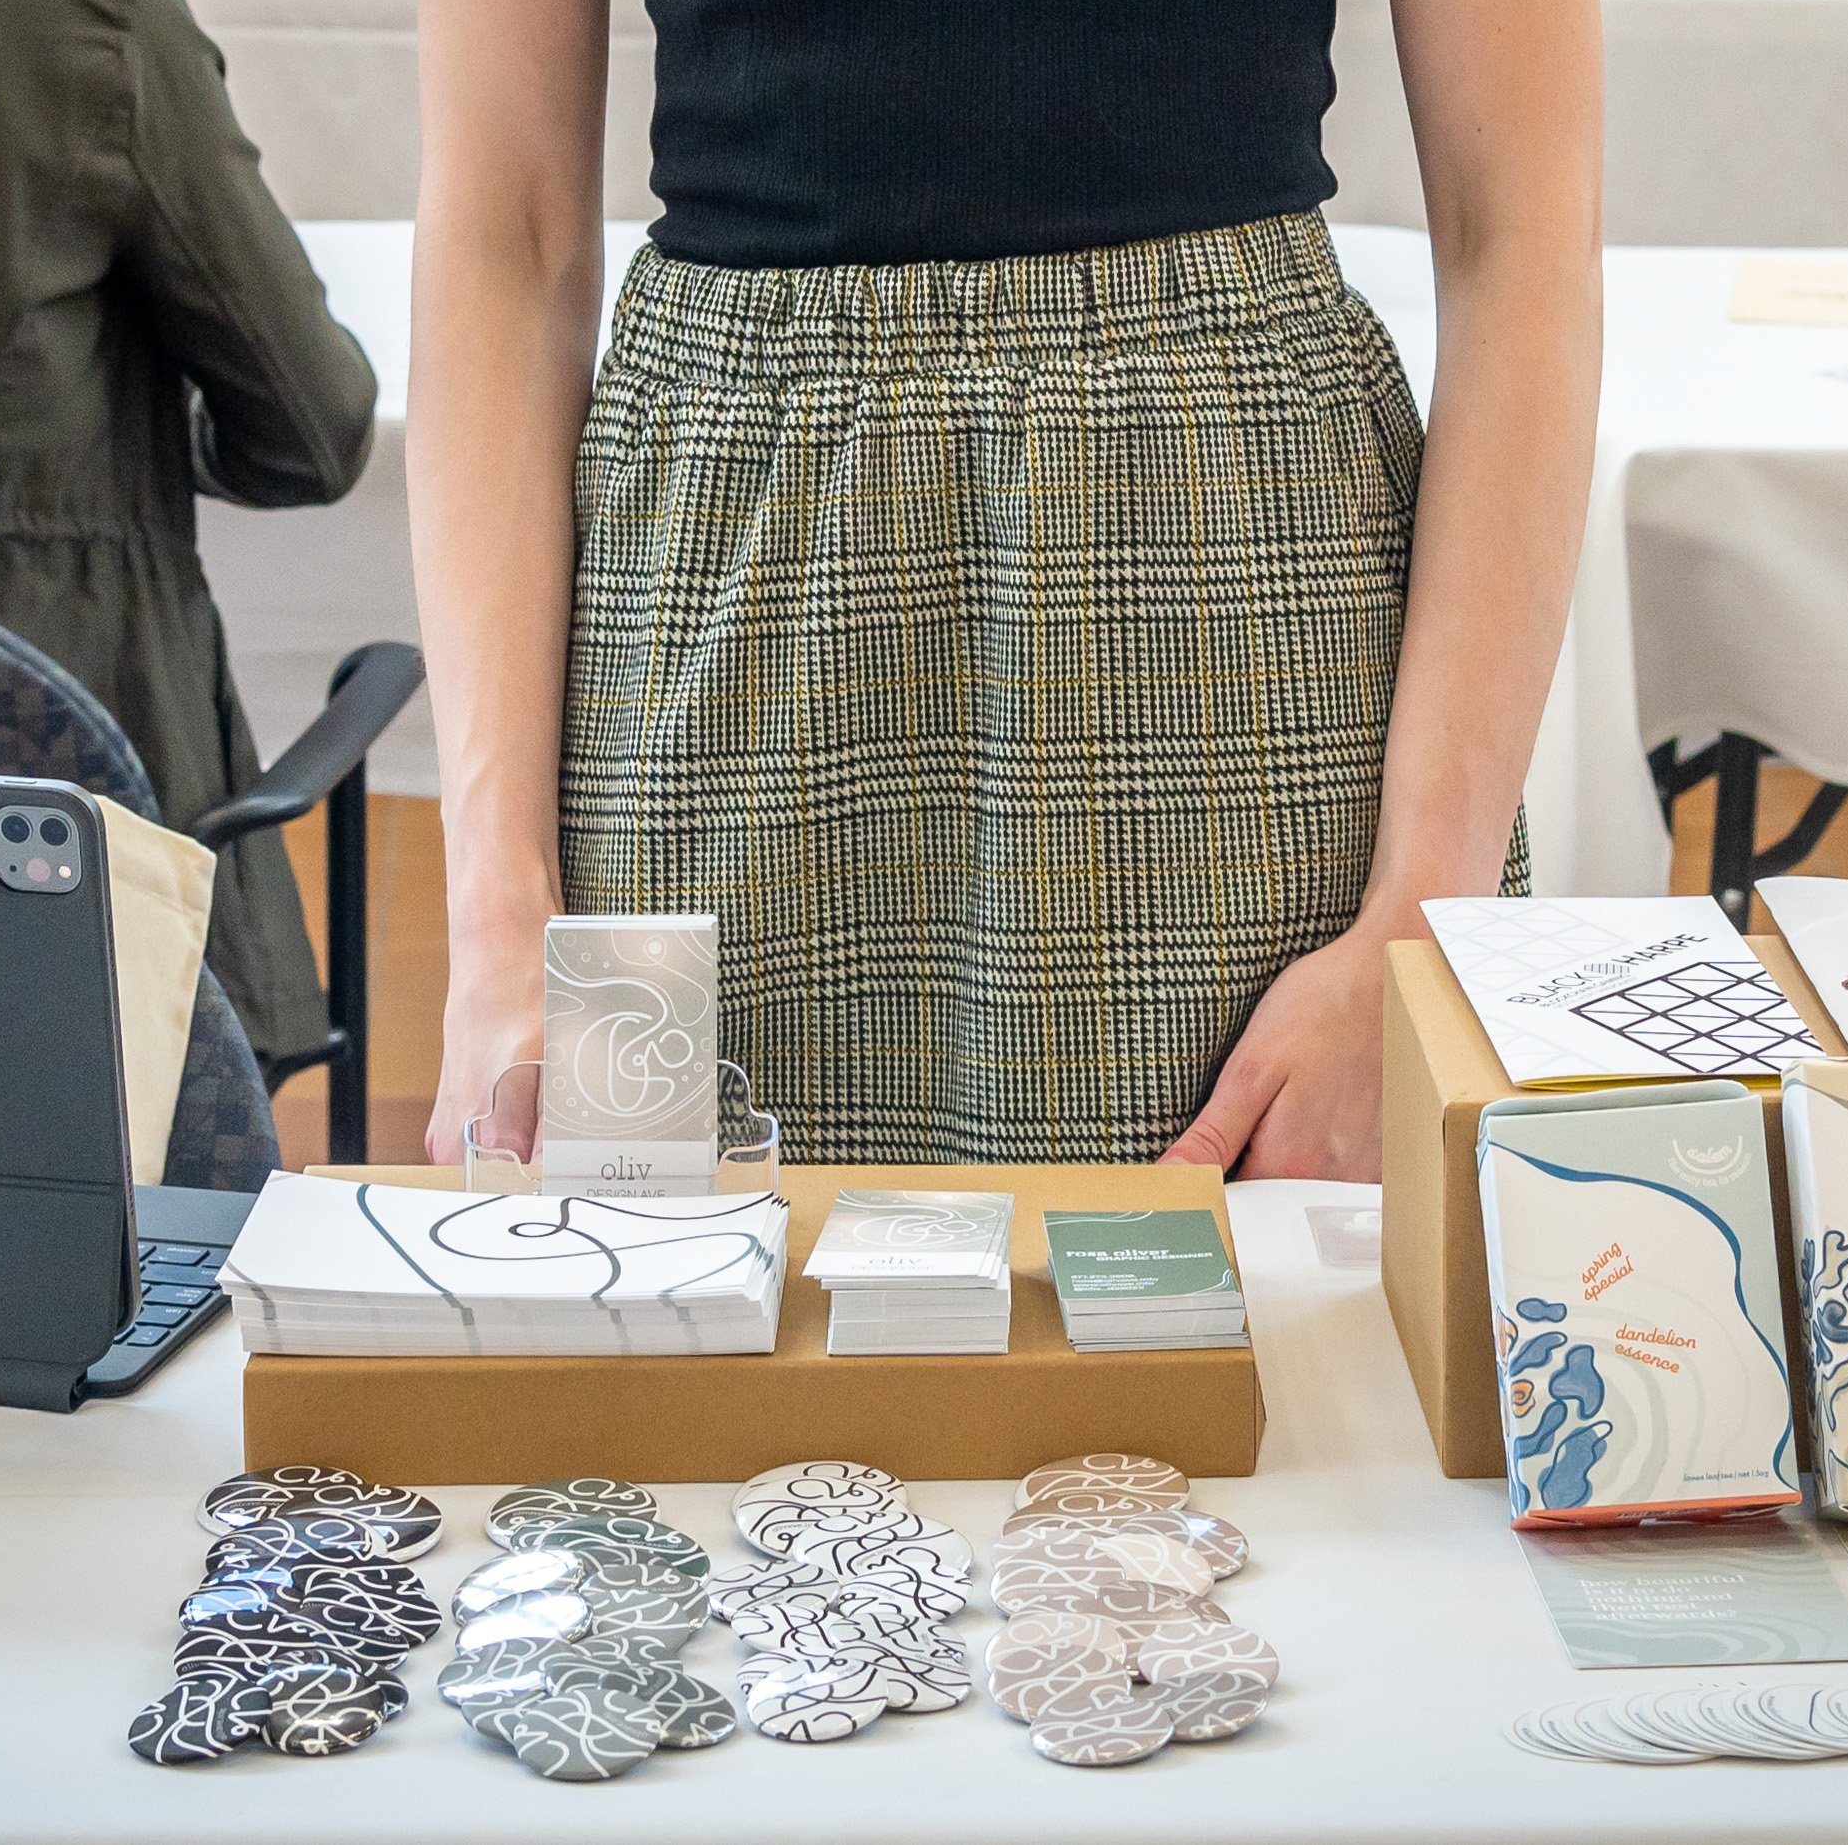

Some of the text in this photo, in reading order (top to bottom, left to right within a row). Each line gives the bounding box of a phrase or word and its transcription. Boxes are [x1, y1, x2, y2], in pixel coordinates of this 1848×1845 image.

[1611, 934, 1709, 965] HARPE
[1506, 972, 1603, 1004] BLACK
[1686, 1145, 1734, 1163] salem
[601, 1156, 652, 1180] oliv
[586, 1188, 666, 1198] DESIGN AVE
[1152, 1252, 1213, 1260] DESIGNER
[1582, 1242, 1622, 1284] spring
[1584, 1255, 1635, 1301] special
[1615, 1323, 1697, 1349] dandelion
[1615, 1343, 1680, 1374] essence
[1580, 1574, 1745, 1588] how beautiful
[1662, 1585, 1690, 1594] do
[1588, 1592, 1734, 1604] nothing and
[1592, 1602, 1697, 1612] then rest
